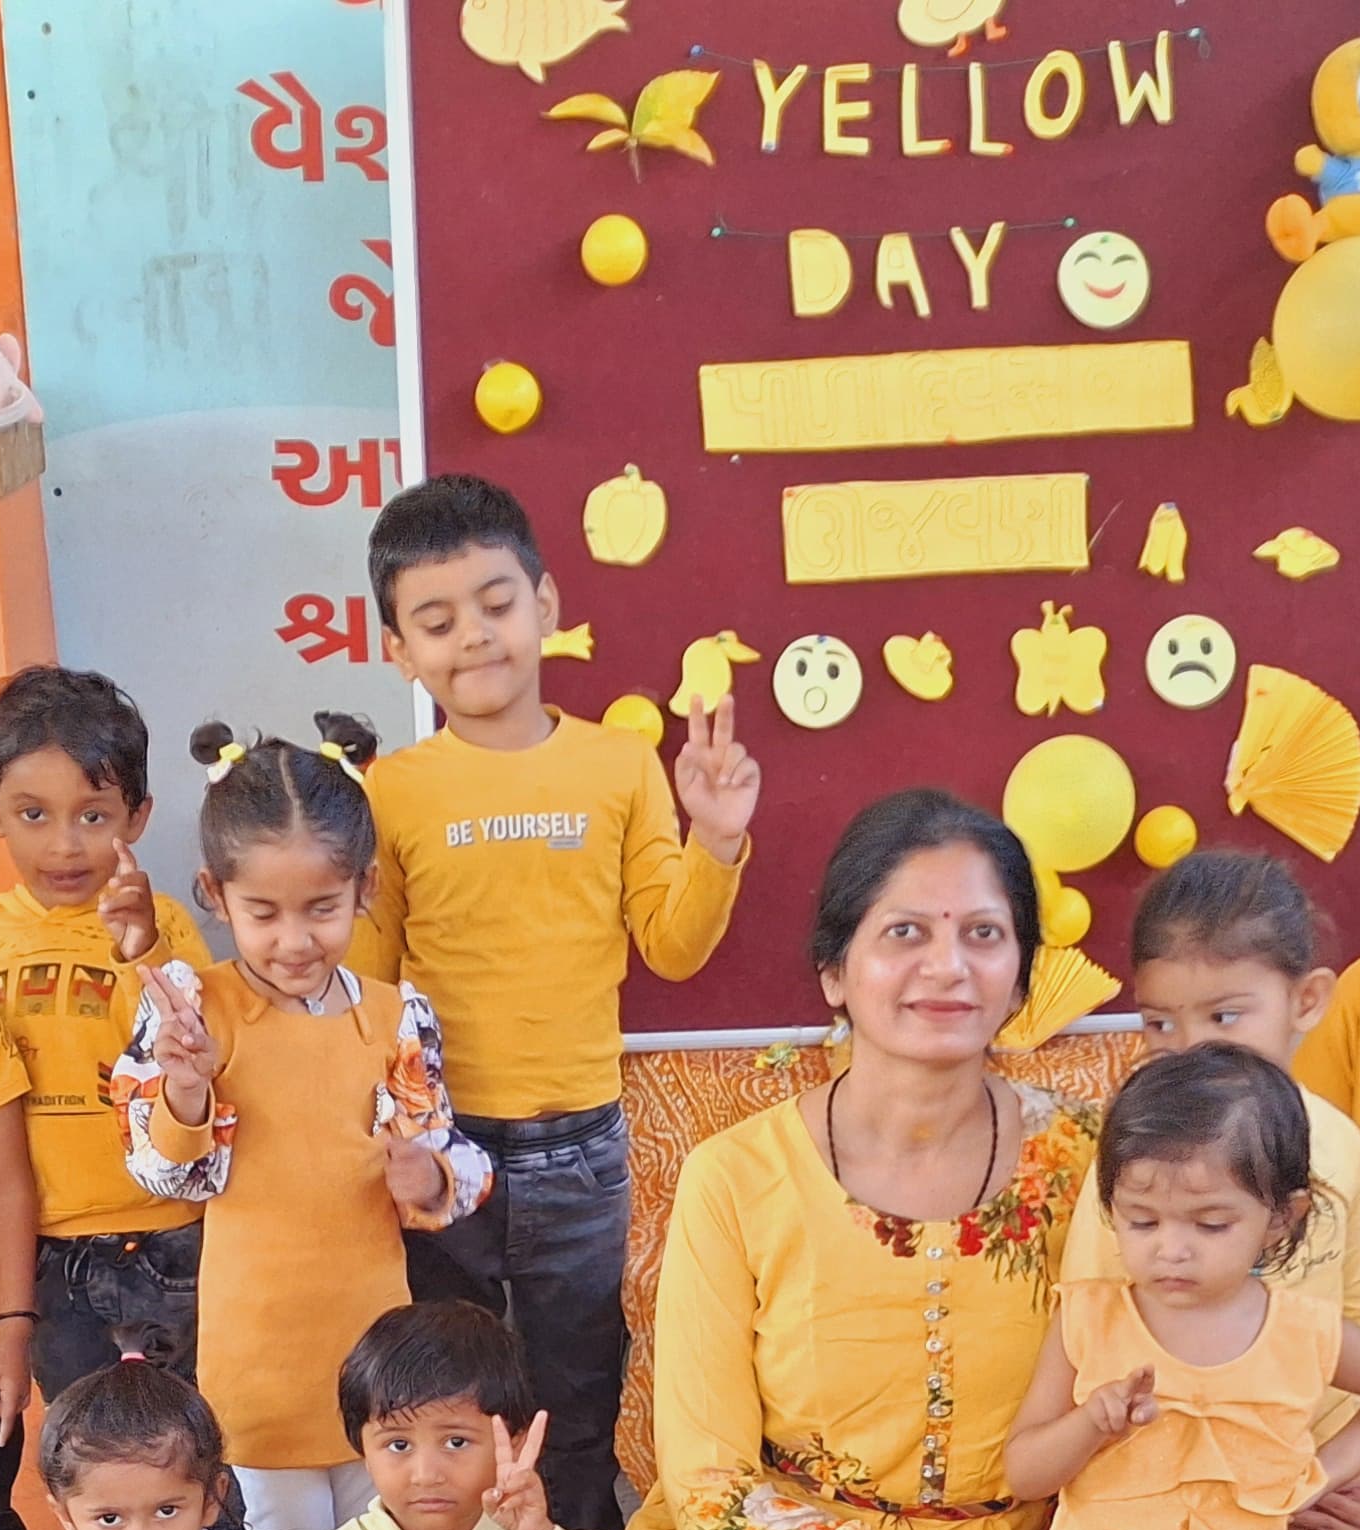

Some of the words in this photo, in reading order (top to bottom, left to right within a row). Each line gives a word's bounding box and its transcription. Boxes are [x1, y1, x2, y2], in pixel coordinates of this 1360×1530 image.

[753, 30, 1176, 156] YELLOW
[788, 221, 1006, 319] DAY
[445, 820, 474, 847] BE
[478, 812, 588, 841] YOURSELF
